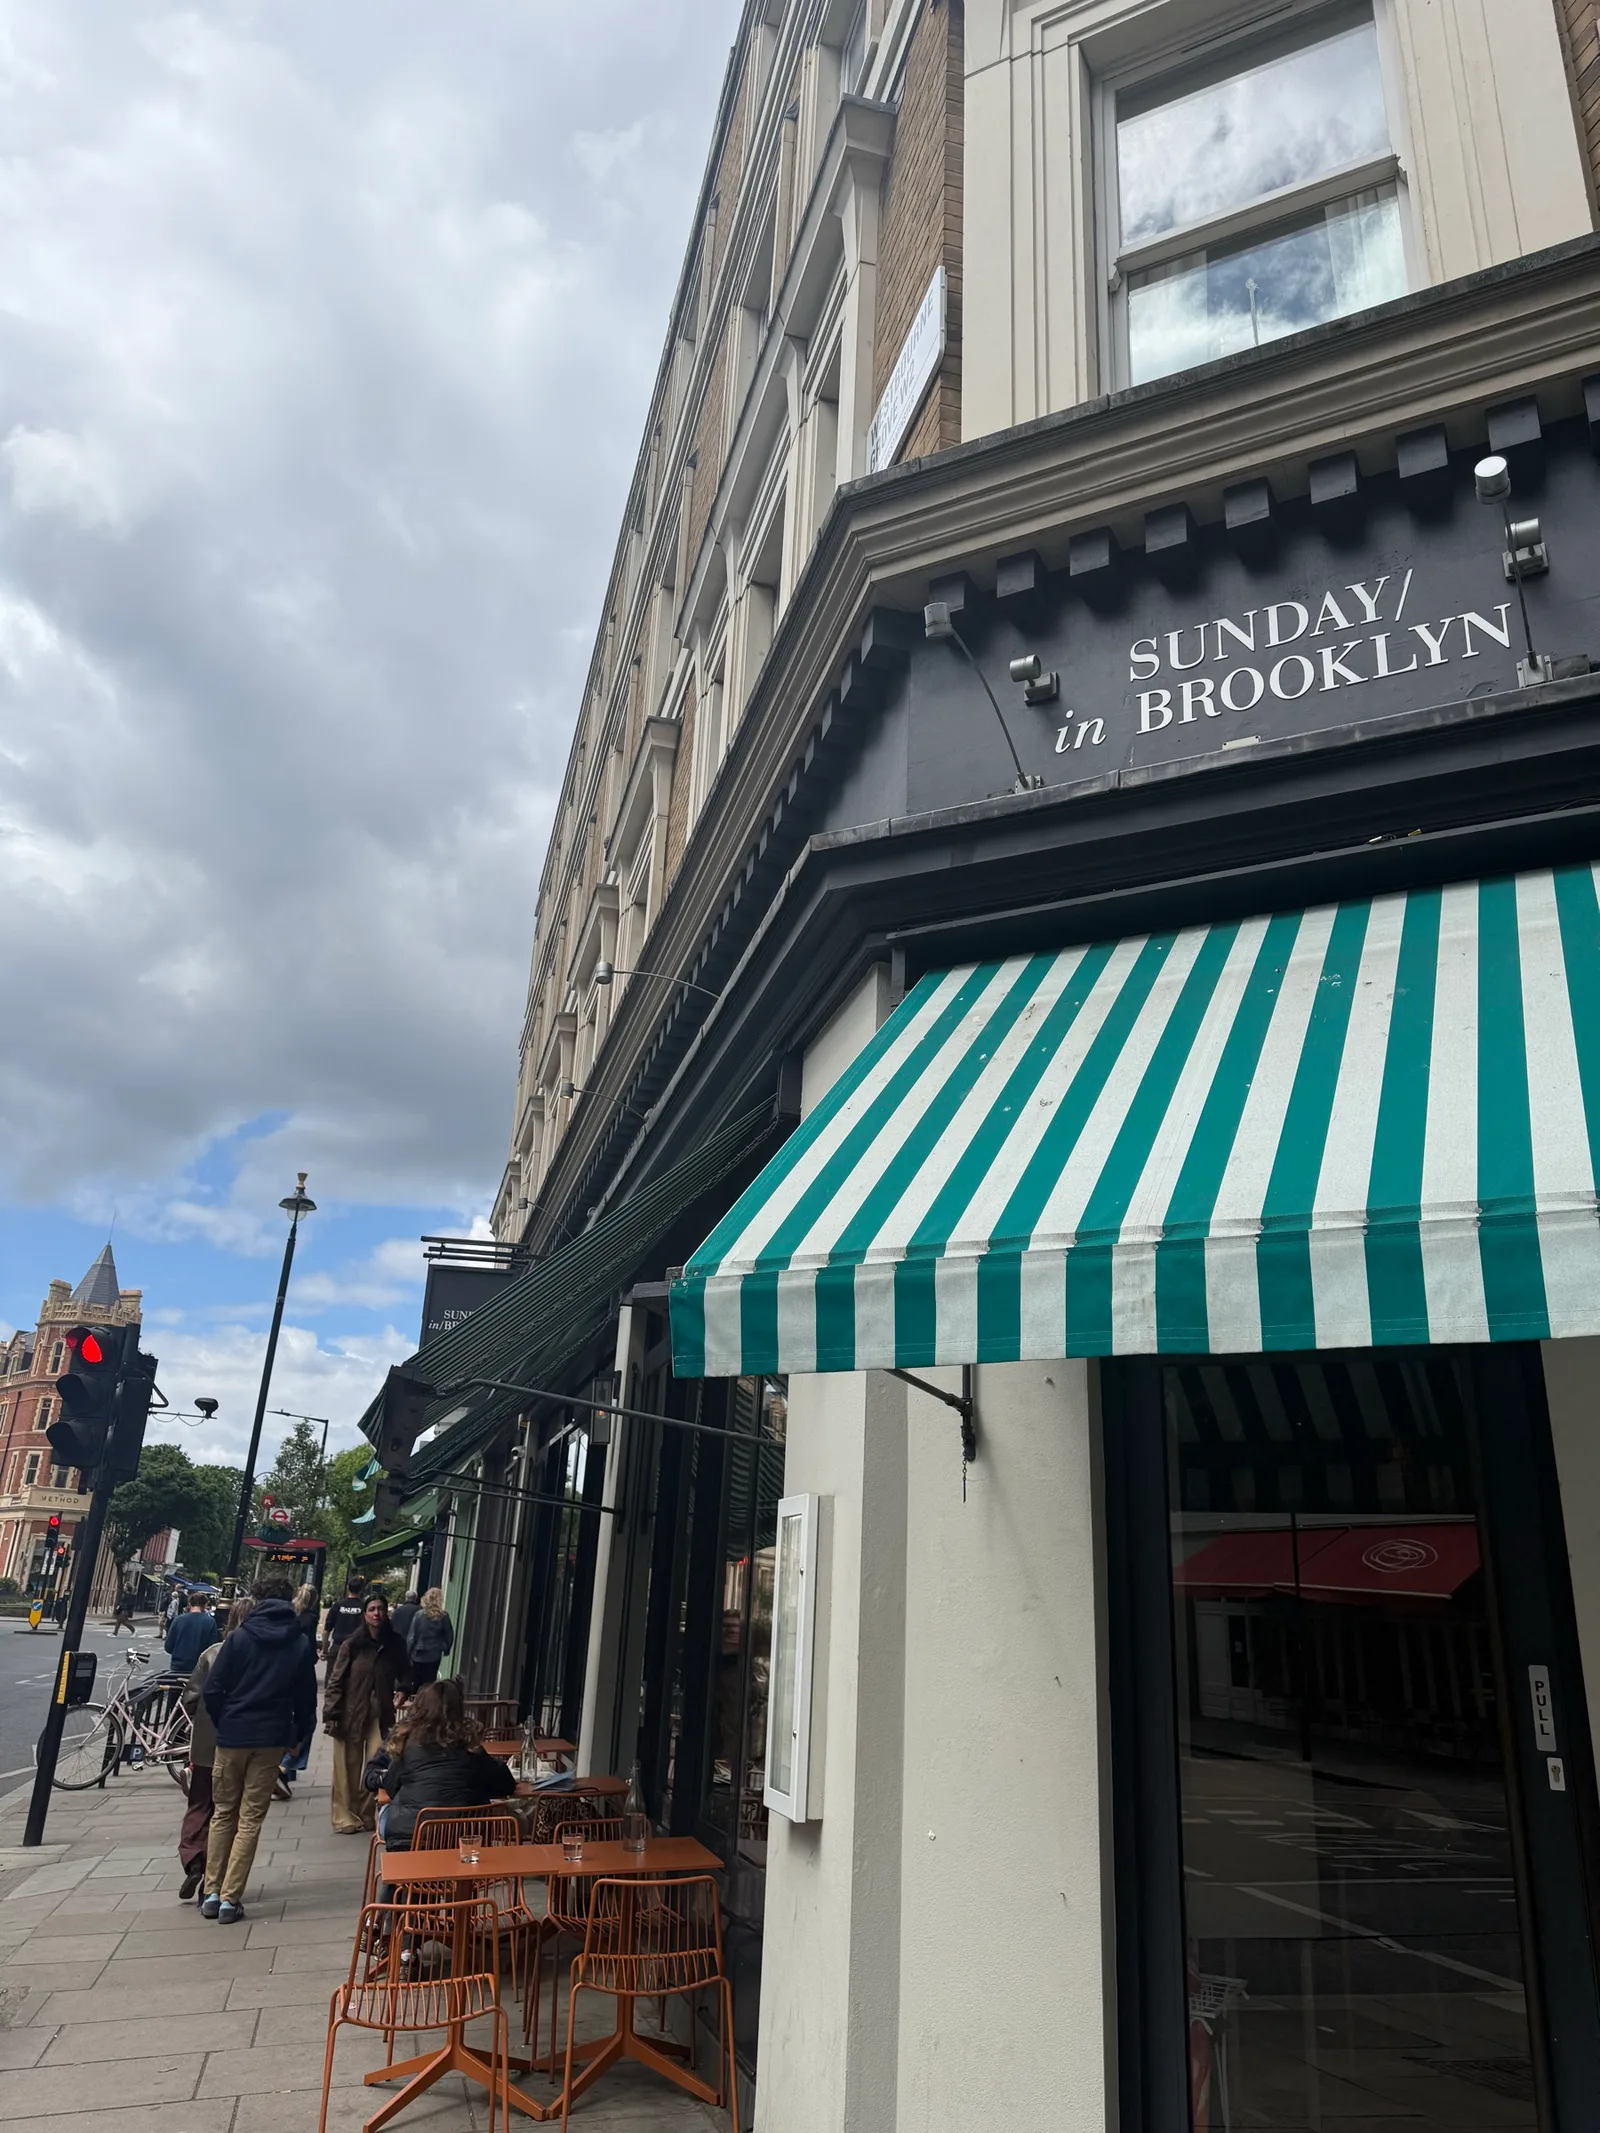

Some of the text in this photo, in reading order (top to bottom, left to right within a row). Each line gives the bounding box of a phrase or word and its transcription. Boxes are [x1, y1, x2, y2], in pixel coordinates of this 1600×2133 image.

[869, 358, 915, 473] GROVE W2
[870, 288, 934, 447] WESTBOURNE
[1054, 602, 1512, 754] in BROOKLYN
[41, 1495, 79, 1504] METHOD
[1534, 1680, 1550, 1736] PULL
